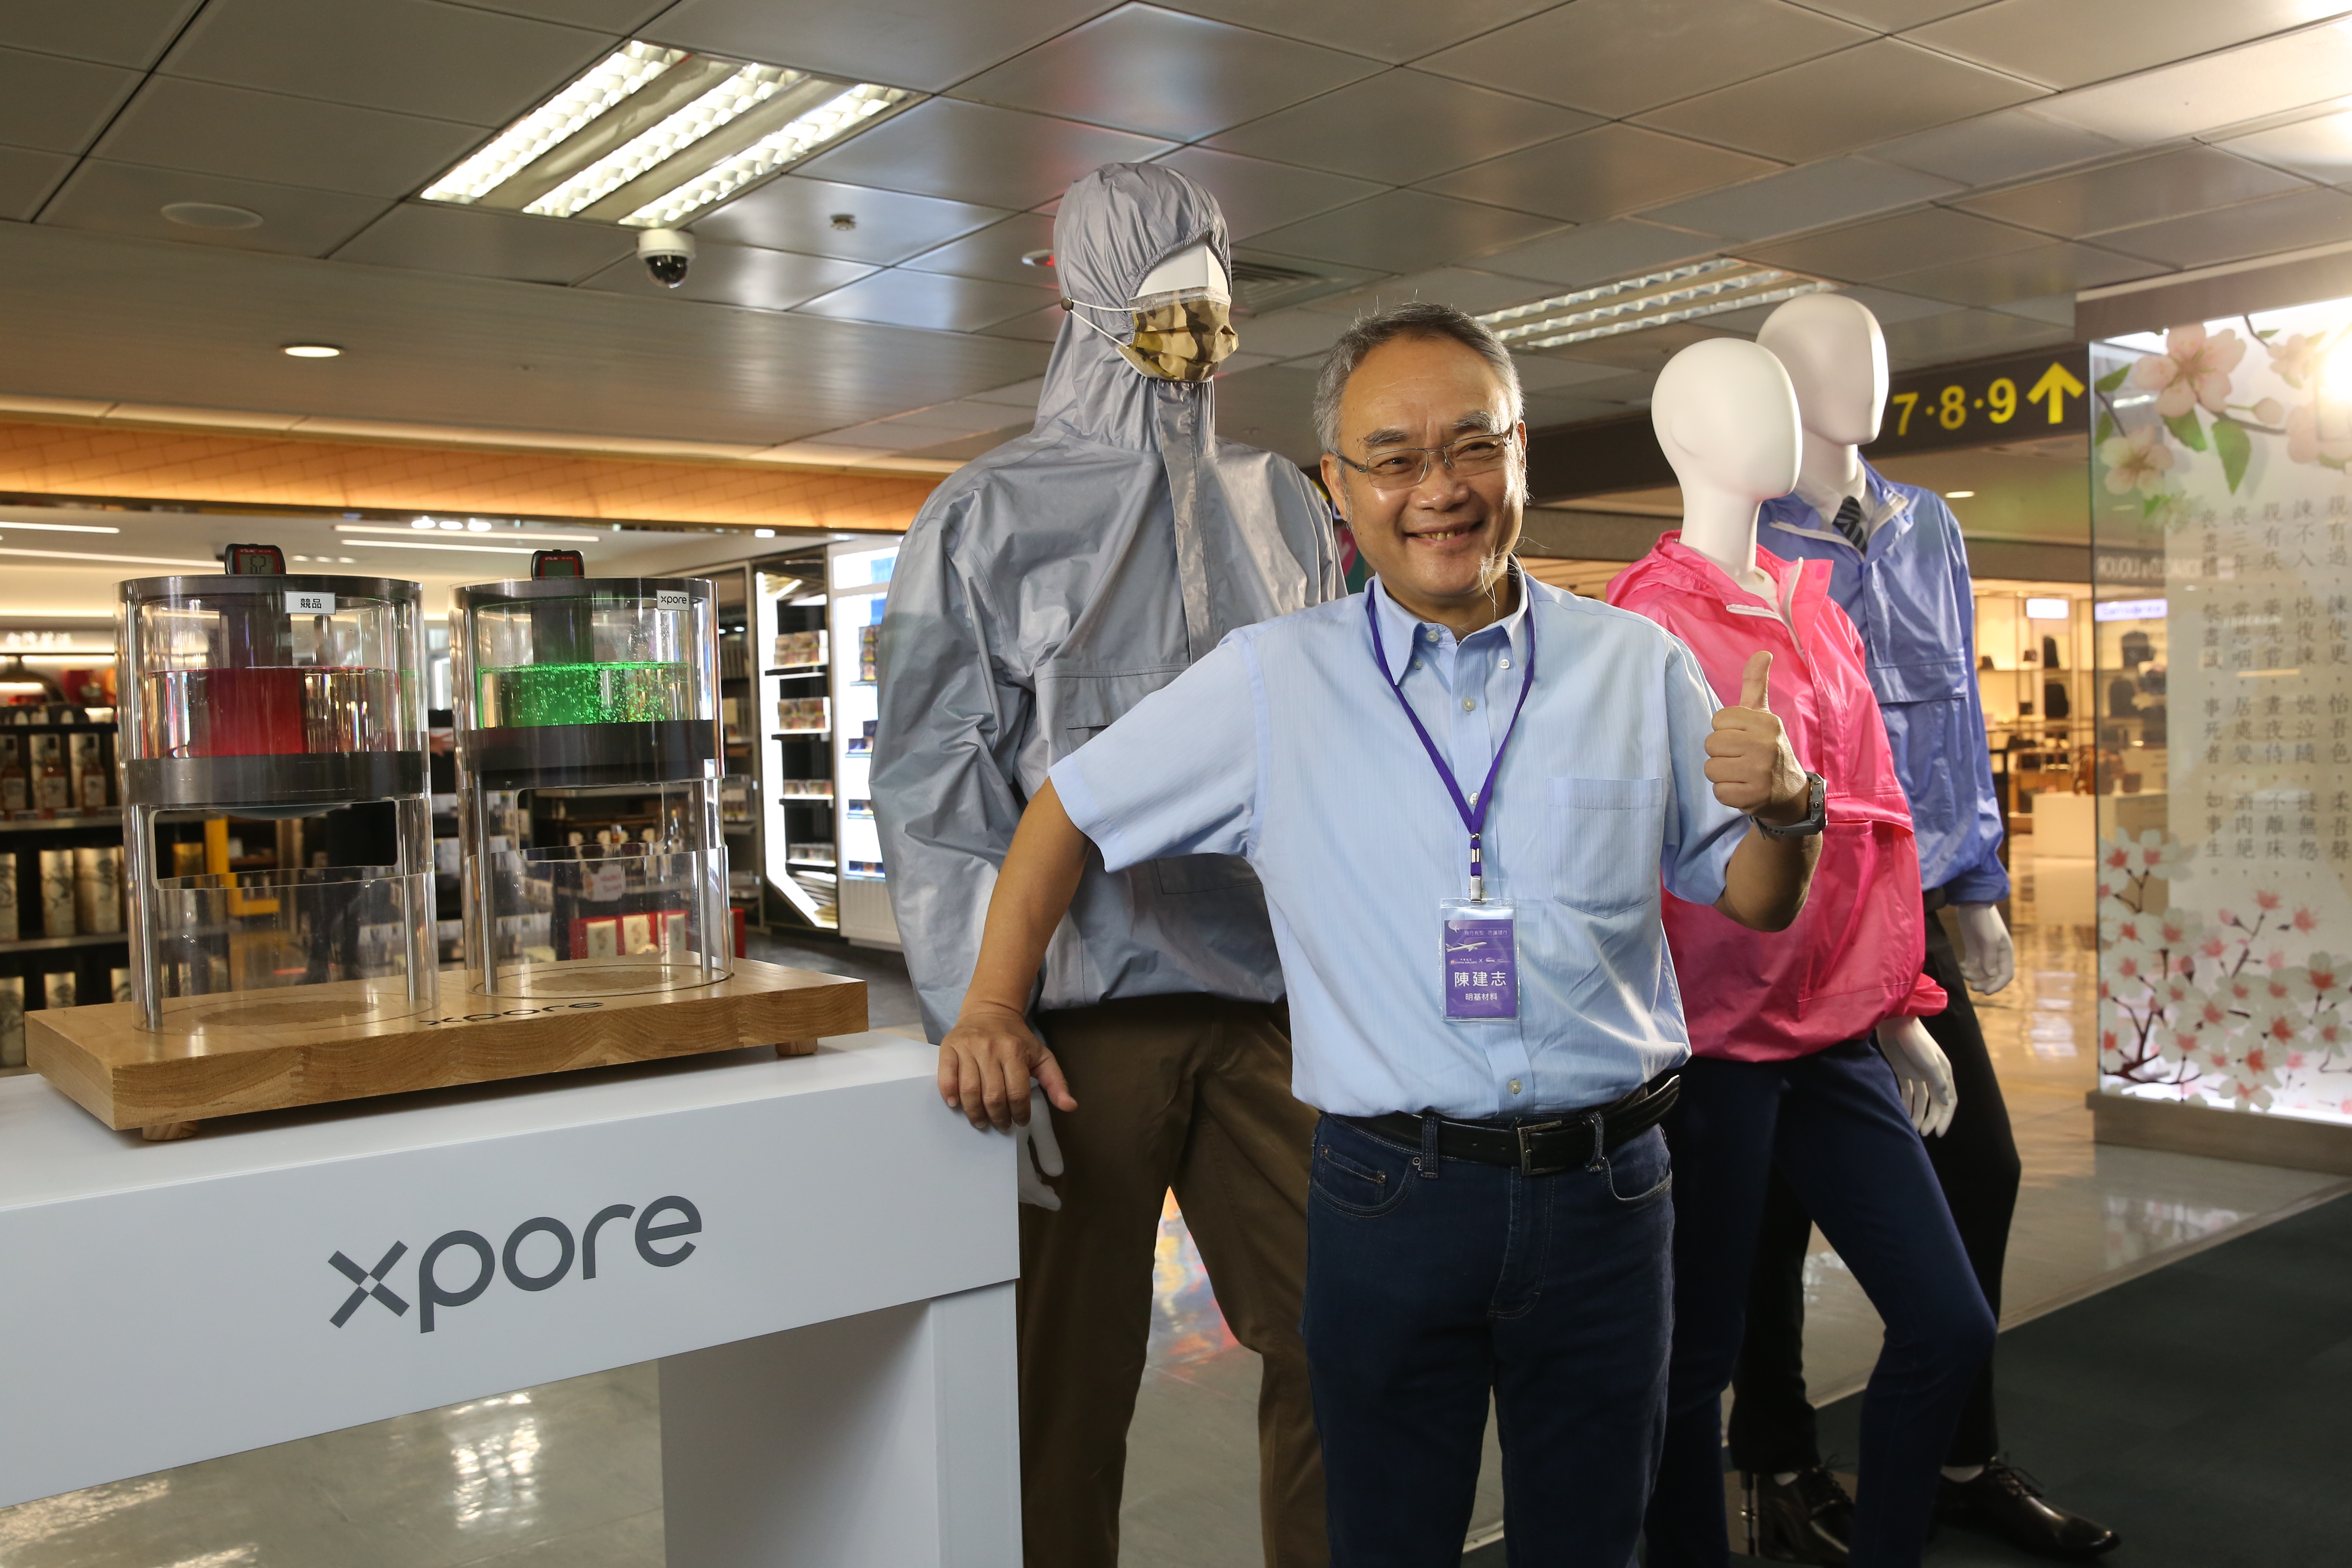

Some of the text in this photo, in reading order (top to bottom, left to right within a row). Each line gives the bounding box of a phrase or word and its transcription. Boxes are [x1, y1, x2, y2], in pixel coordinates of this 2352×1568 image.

[300, 598, 322, 609] 競品
[660, 596, 687, 605] xpore
[1454, 971, 1506, 987] 陳建志
[1465, 993, 1497, 1001] 明基材料
[419, 1002, 604, 1026] xpore
[328, 1195, 702, 1334] xpore
